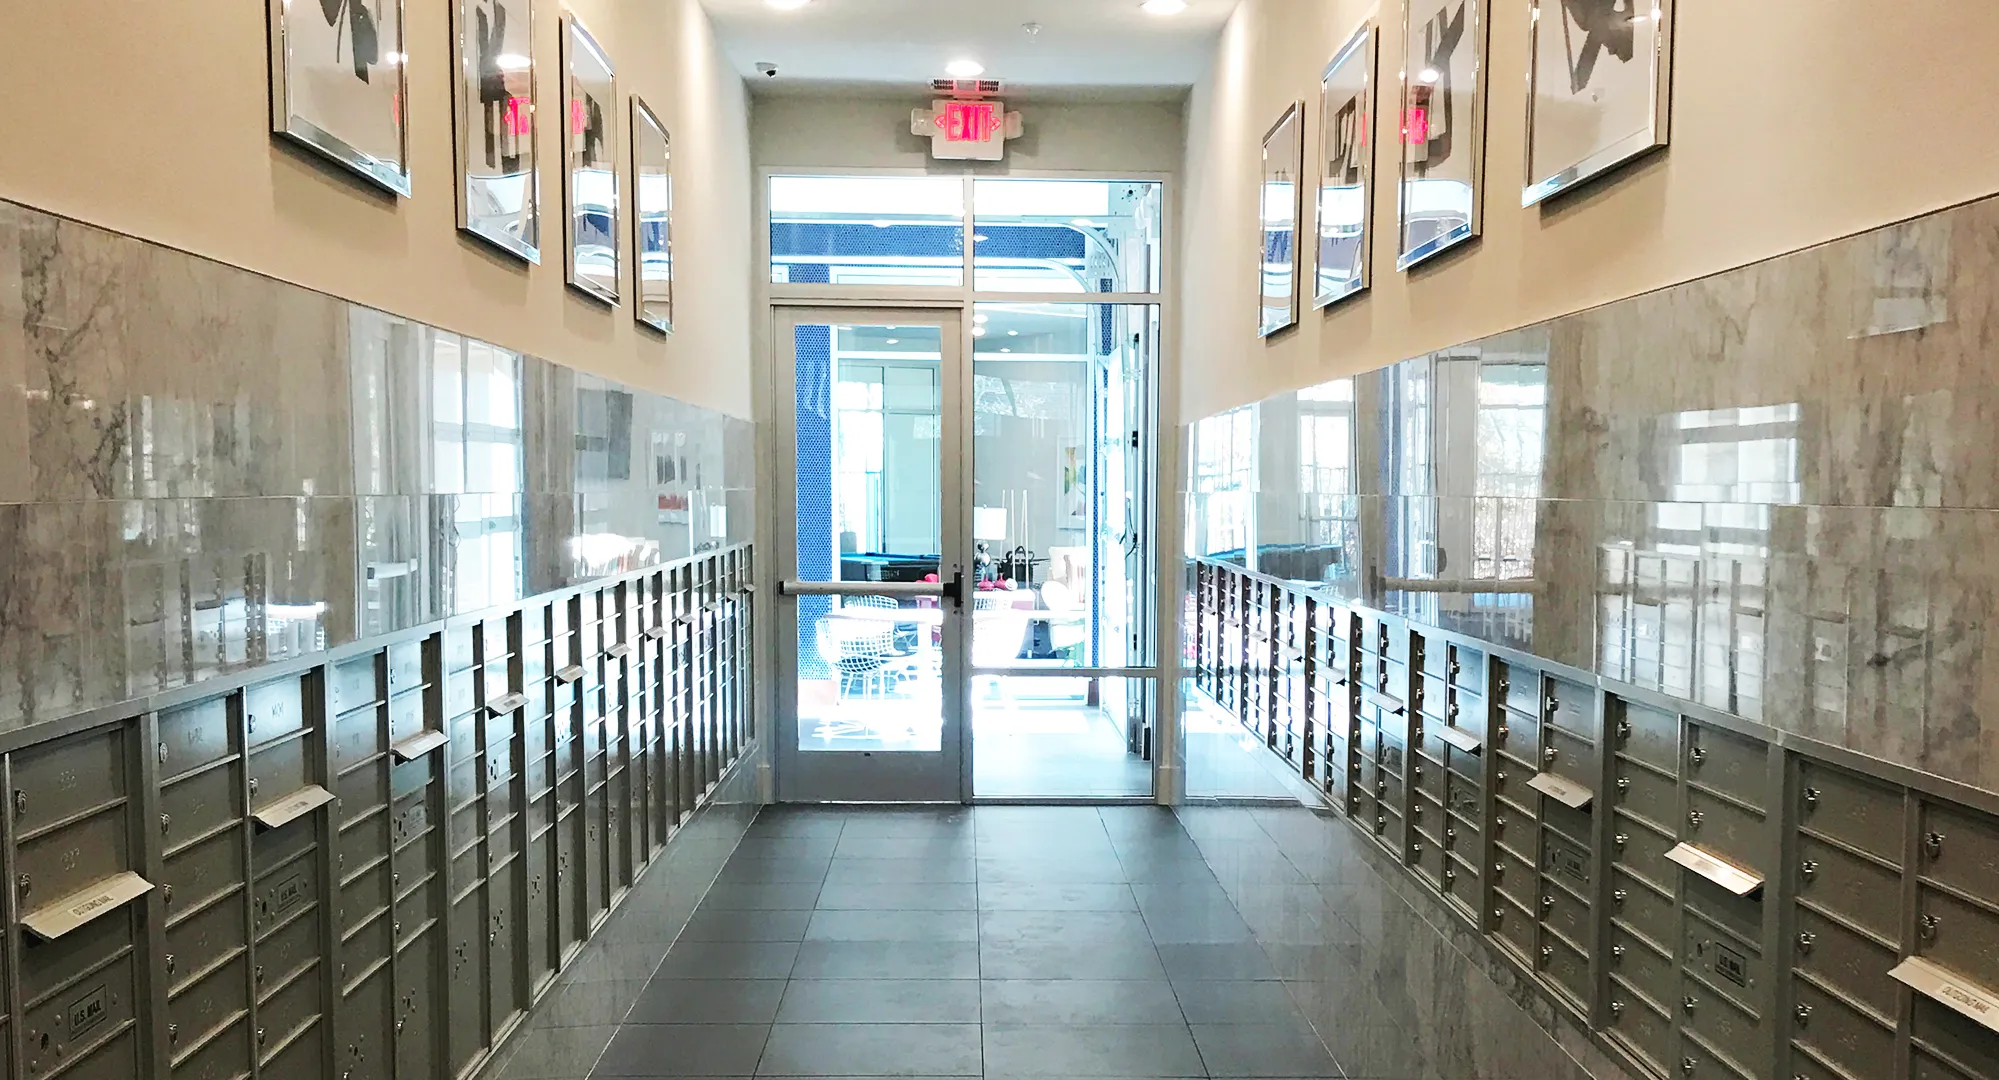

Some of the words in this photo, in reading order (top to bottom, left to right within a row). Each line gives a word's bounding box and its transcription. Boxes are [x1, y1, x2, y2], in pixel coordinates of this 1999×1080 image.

[945, 103, 993, 141] EXIT
[74, 1009, 86, 1026] U.S.
[87, 999, 102, 1018] MAIL
